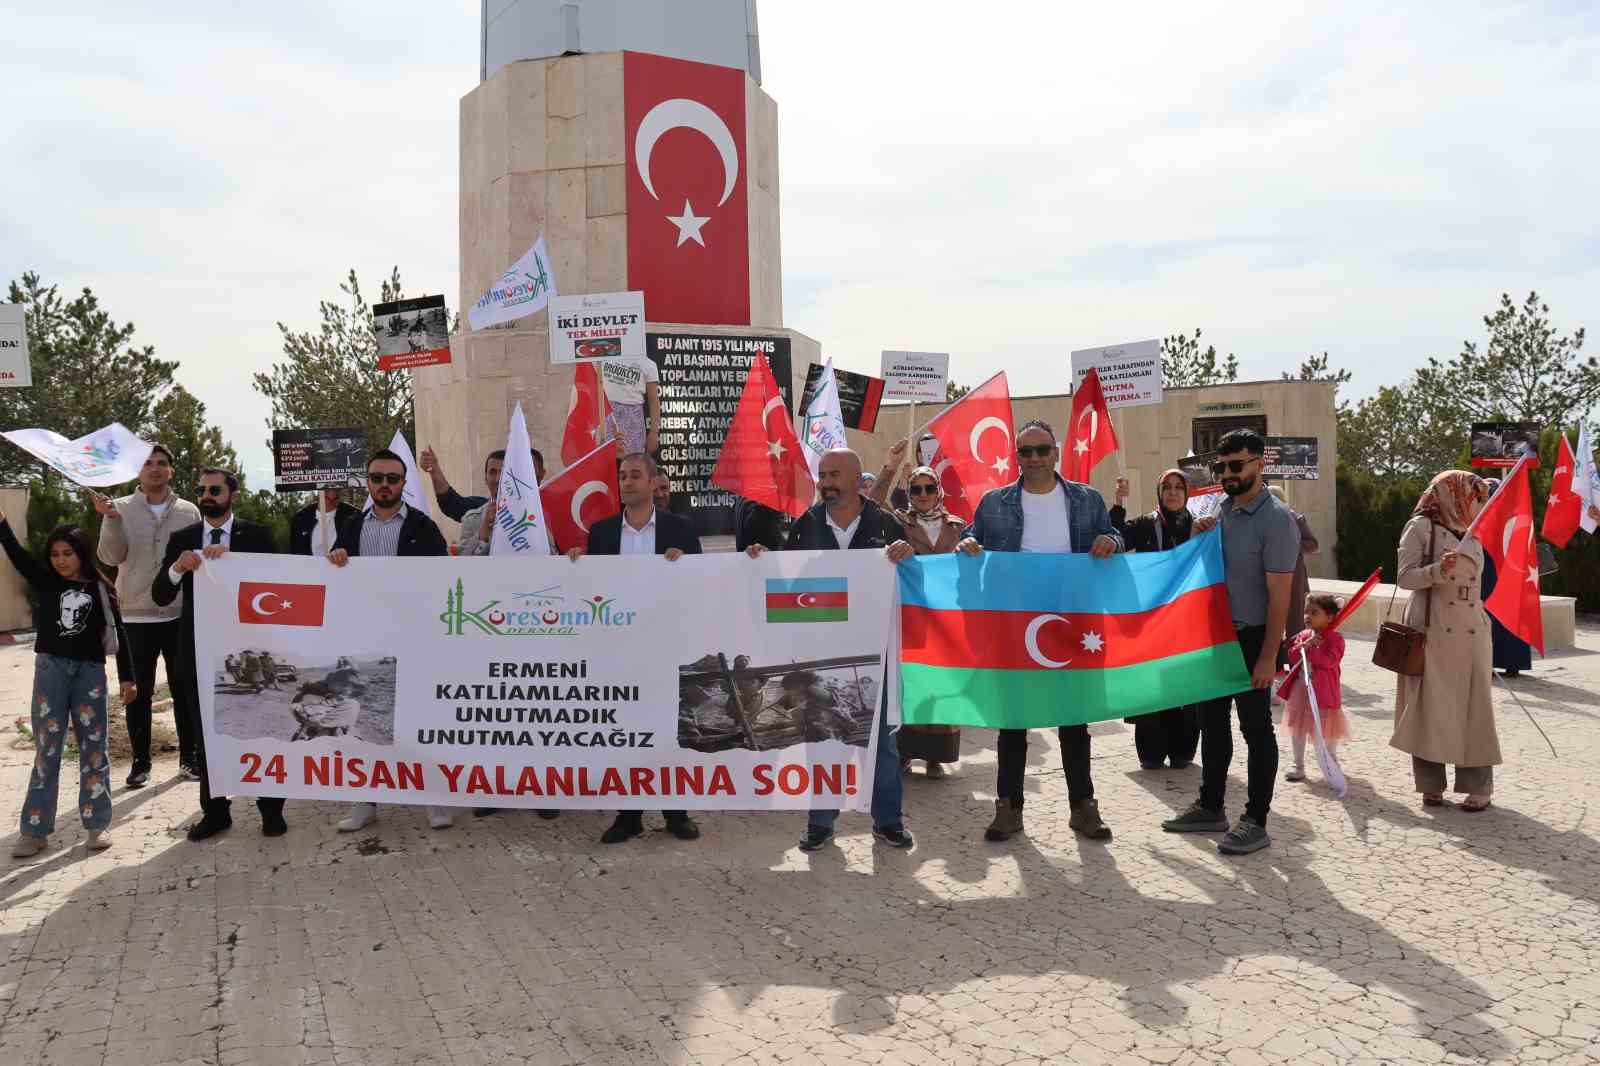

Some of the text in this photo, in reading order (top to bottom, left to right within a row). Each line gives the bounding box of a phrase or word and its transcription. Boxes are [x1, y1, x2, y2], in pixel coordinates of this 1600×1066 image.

[557, 313, 638, 329] İKİ DEVLET
[566, 330, 588, 339] TEK
[657, 338, 775, 353] BU ANIT 1915 YILI MAYIS
[664, 353, 681, 366] AYI
[684, 354, 729, 368] BAŞINDA
[1113, 359, 1155, 371] TARAFINDAN
[661, 369, 719, 382] TOPLANAN
[721, 370, 735, 382] VE
[656, 383, 721, 398] OMİTACILARI
[1101, 382, 1135, 393] NUTMA
[488, 660, 587, 679] ERMENİ
[436, 682, 640, 702] KATLİAMLARINI
[455, 707, 617, 724] UNUTMADIK
[240, 750, 858, 797] 24 NİSAN YALANLARINA SON!
